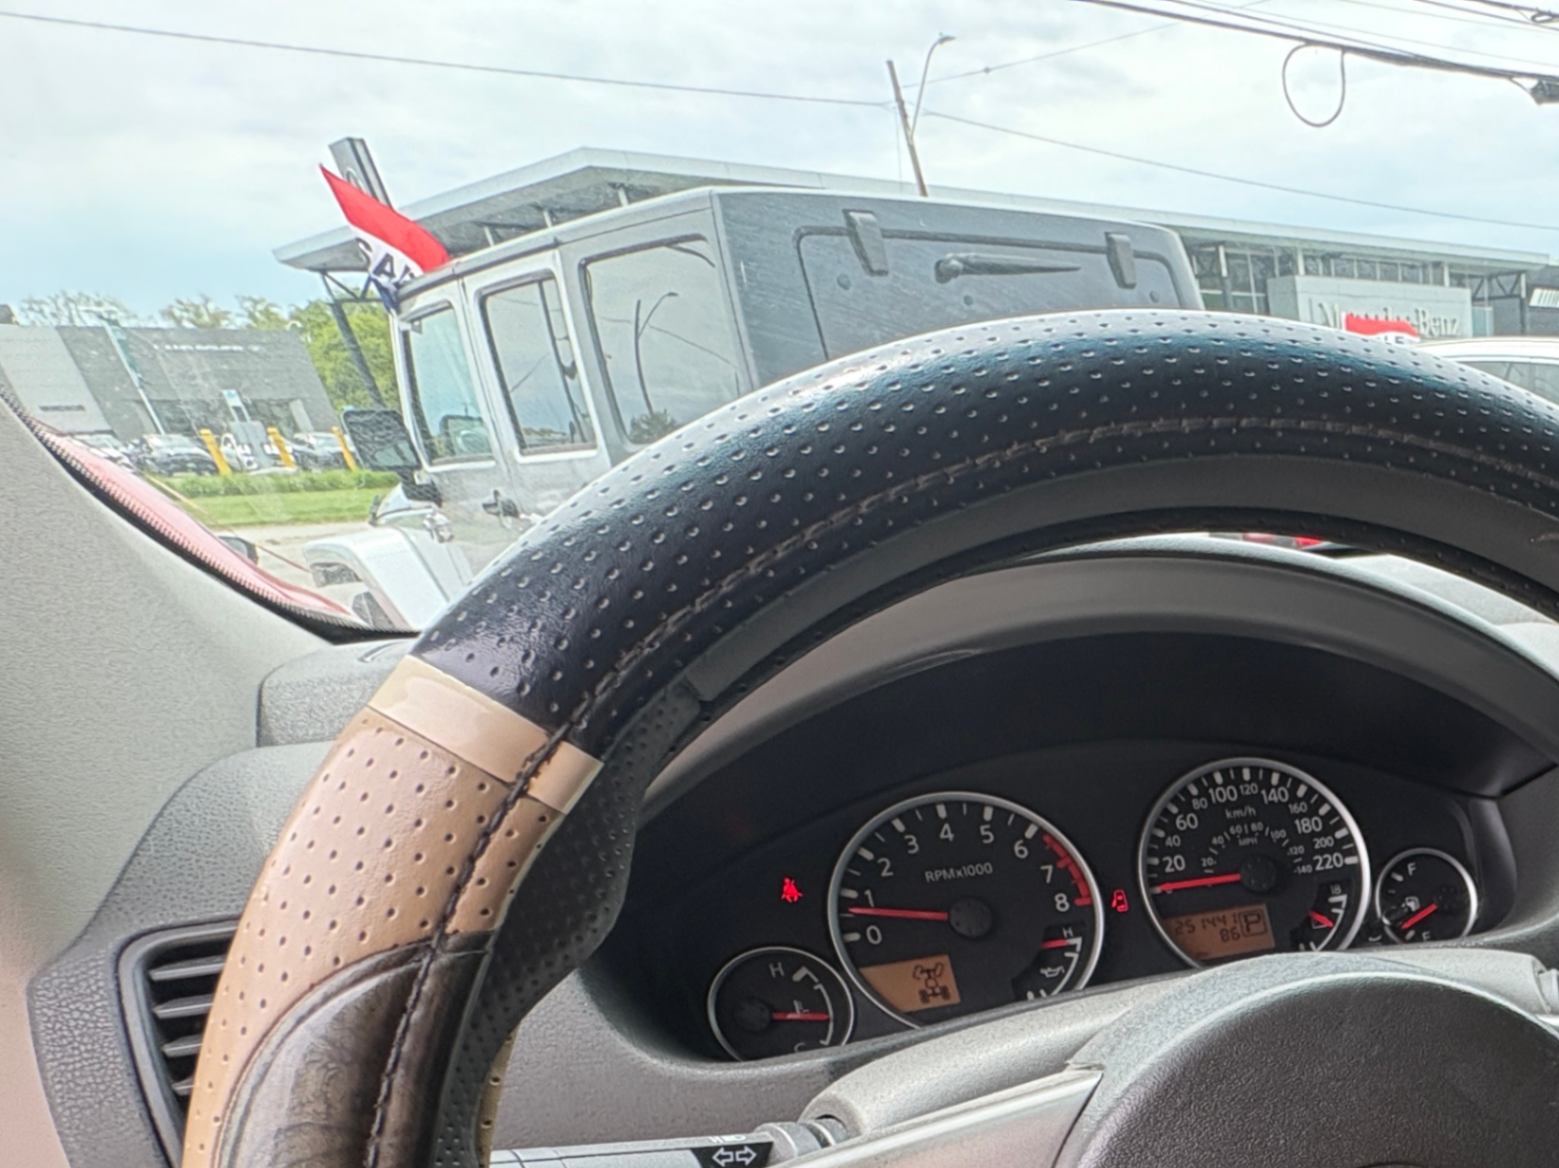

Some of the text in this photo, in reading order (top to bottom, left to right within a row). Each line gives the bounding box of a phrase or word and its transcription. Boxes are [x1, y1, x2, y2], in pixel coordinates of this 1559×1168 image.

[1208, 786, 1238, 803] 100
[1240, 783, 1258, 795] 120
[1261, 786, 1289, 804] 140
[1192, 797, 1208, 810] 80
[1225, 806, 1256, 819] km/h
[1288, 801, 1307, 814] 160
[1175, 812, 1198, 830] 60
[1294, 815, 1323, 834] 180
[939, 823, 955, 842] 4
[979, 824, 995, 844] 5
[1165, 835, 1181, 848] 40
[904, 834, 920, 855] 3
[1013, 839, 1029, 859] 6
[1313, 837, 1334, 850] 200
[877, 857, 894, 878] 2
[1162, 855, 1186, 873] 20
[1314, 853, 1344, 872] 220
[1407, 862, 1417, 877] F
[924, 861, 993, 884] RPMx1000
[1040, 864, 1053, 884] 7
[863, 889, 875, 907] 1
[1054, 893, 1070, 913] 8
[1175, 911, 1238, 936] 251441
[1243, 911, 1261, 933] P
[865, 924, 883, 945] 0
[1062, 926, 1074, 939] H
[1220, 926, 1241, 942] 86
[768, 961, 785, 979] H
